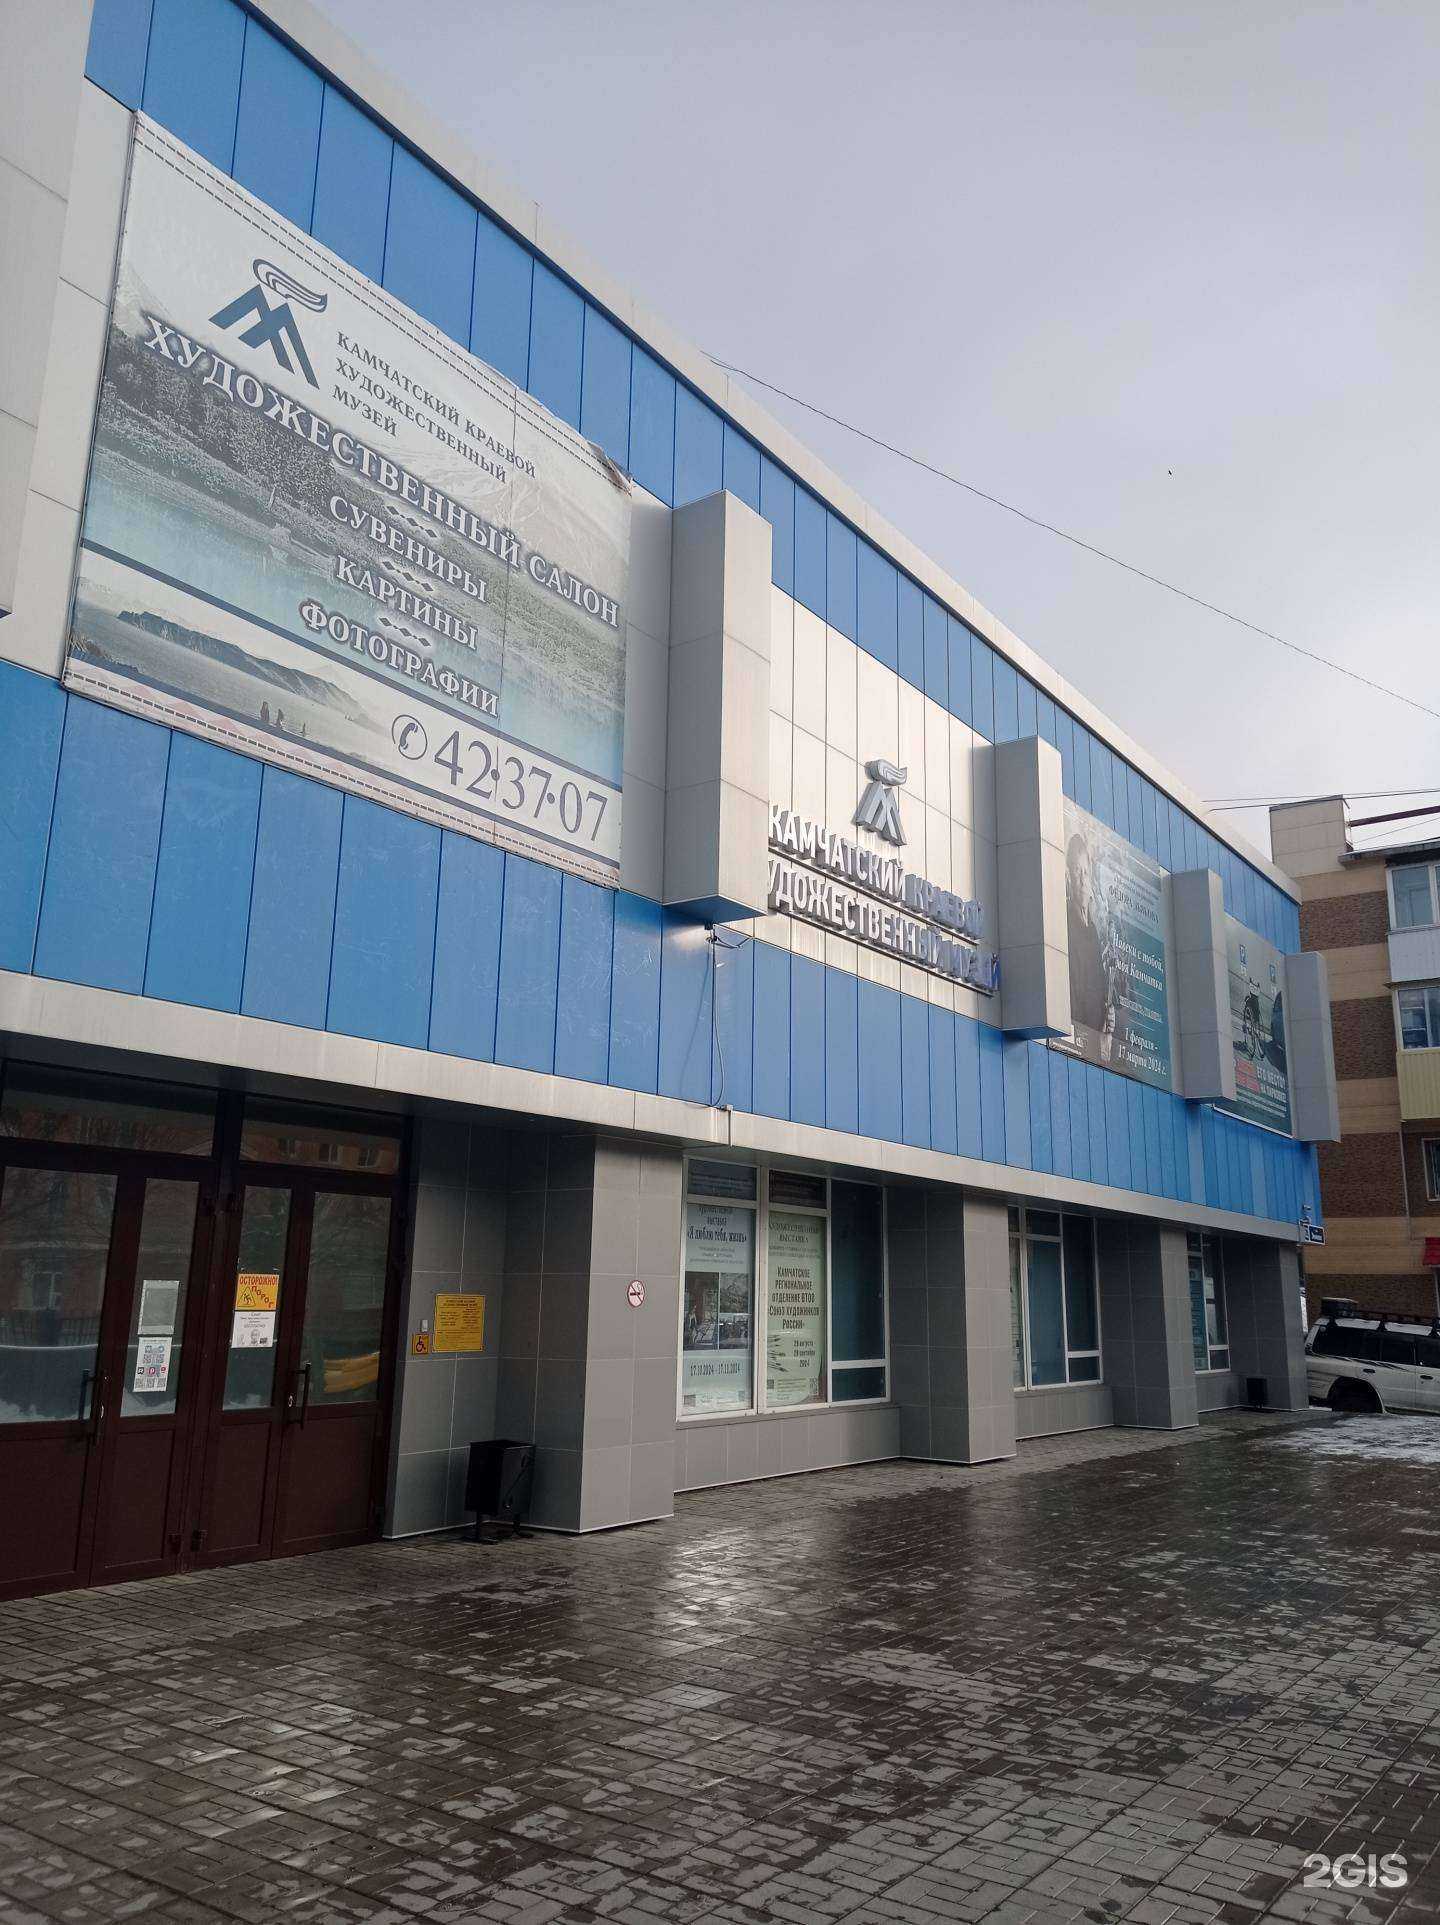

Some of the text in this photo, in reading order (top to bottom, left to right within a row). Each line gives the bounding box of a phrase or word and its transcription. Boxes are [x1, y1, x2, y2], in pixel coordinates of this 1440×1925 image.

[332, 384, 398, 438] МУЗЕЙ
[335, 357, 508, 484] ХУДОЖЕСТВЕННЫЙ
[337, 331, 537, 479] КАМЧАТСКИЙ КРАЕВОЙ
[143, 316, 620, 628] ХУДОЖЕСТВЕННЫЙ САЛОН
[329, 494, 487, 604] СУВЕНИРЫ
[335, 555, 479, 652] КАРТИНЫ
[300, 601, 499, 718] ФОТОГРАФИИ
[769, 803, 905, 903] КАМЧАТСКИЙ
[769, 858, 943, 968] УДОЖЕСТВЕННЫЙ
